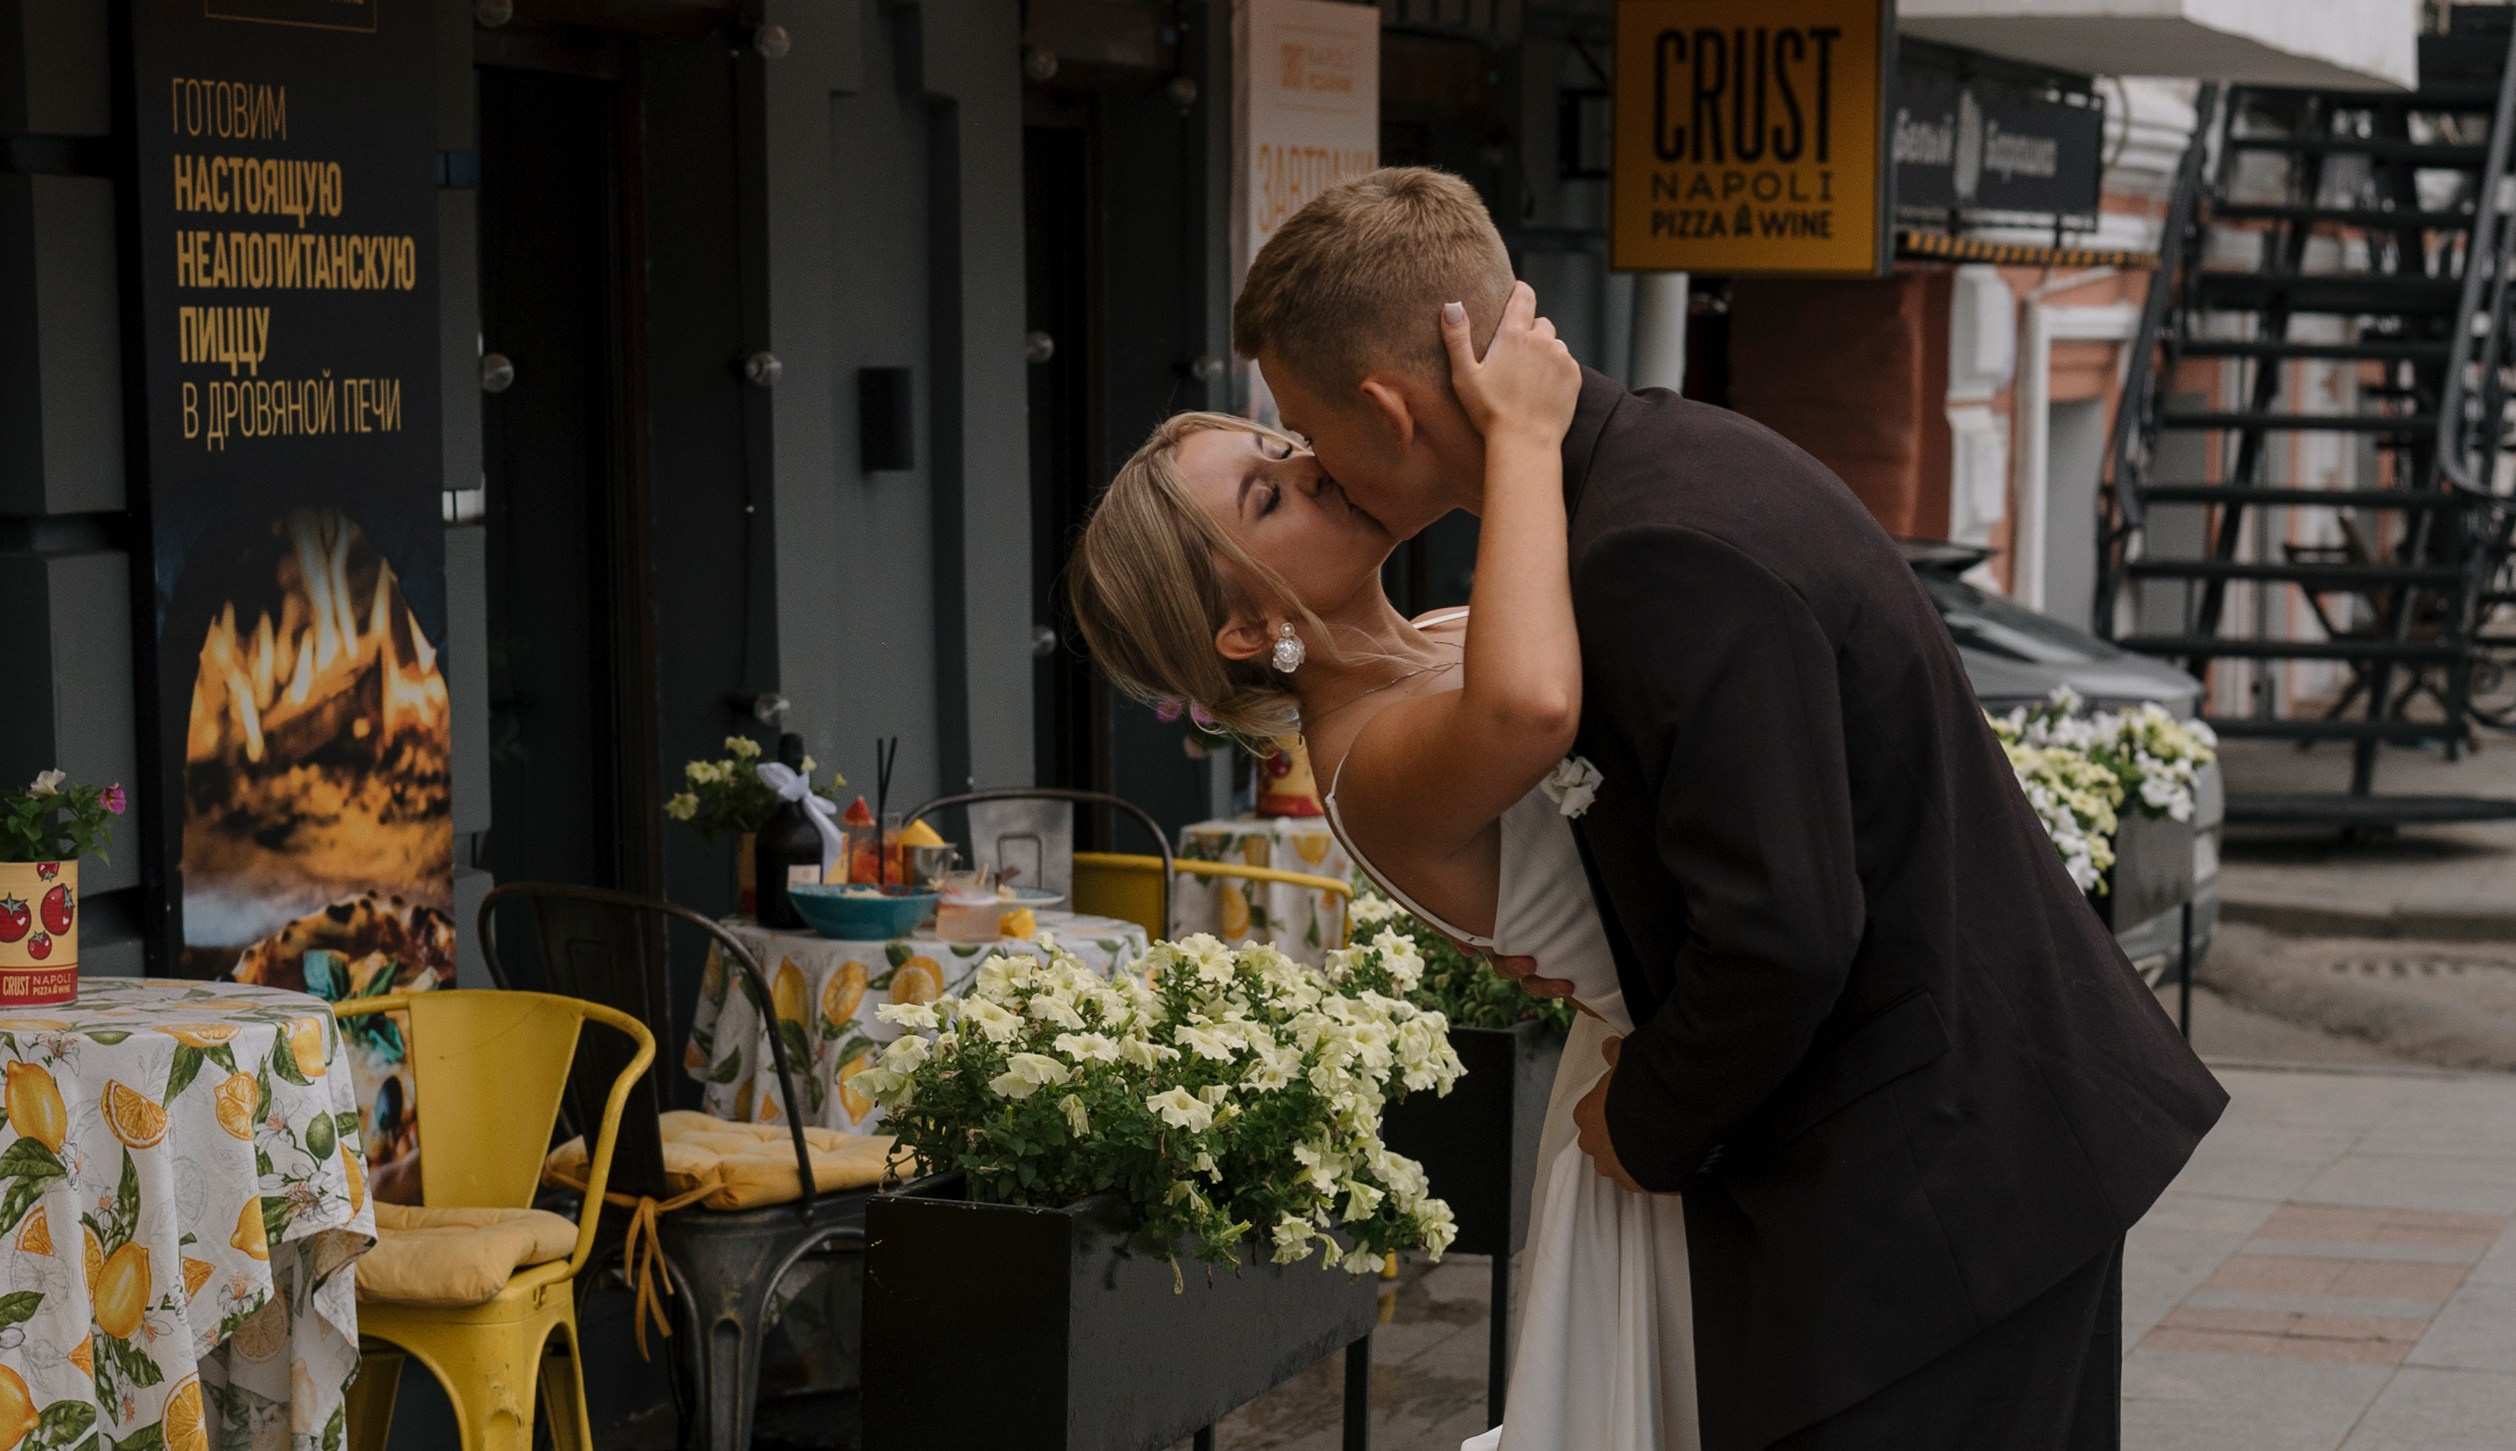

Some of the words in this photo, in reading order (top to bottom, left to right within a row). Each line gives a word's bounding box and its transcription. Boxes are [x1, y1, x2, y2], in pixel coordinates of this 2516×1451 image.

[172, 78, 287, 140] ГОТОВИМ
[1654, 28, 1841, 164] CRUST
[174, 153, 343, 229] НАСТОЯЩУЮ
[1650, 170, 1834, 203] NAPOLI
[1650, 208, 1728, 239] PIZZA
[1758, 209, 1834, 239] WINE
[176, 230, 416, 291] НЕАПОЛИТАНСКУЮ
[179, 306, 271, 377] ПИЦЦУ
[182, 381, 200, 439] В
[206, 368, 337, 452] ДРОВЯНОЙ
[343, 377, 402, 434] ПЕЧИ
[3, 976, 30, 996] CRUST
[33, 974, 71, 985] NAPOLI
[33, 986, 52, 995] PIZZA
